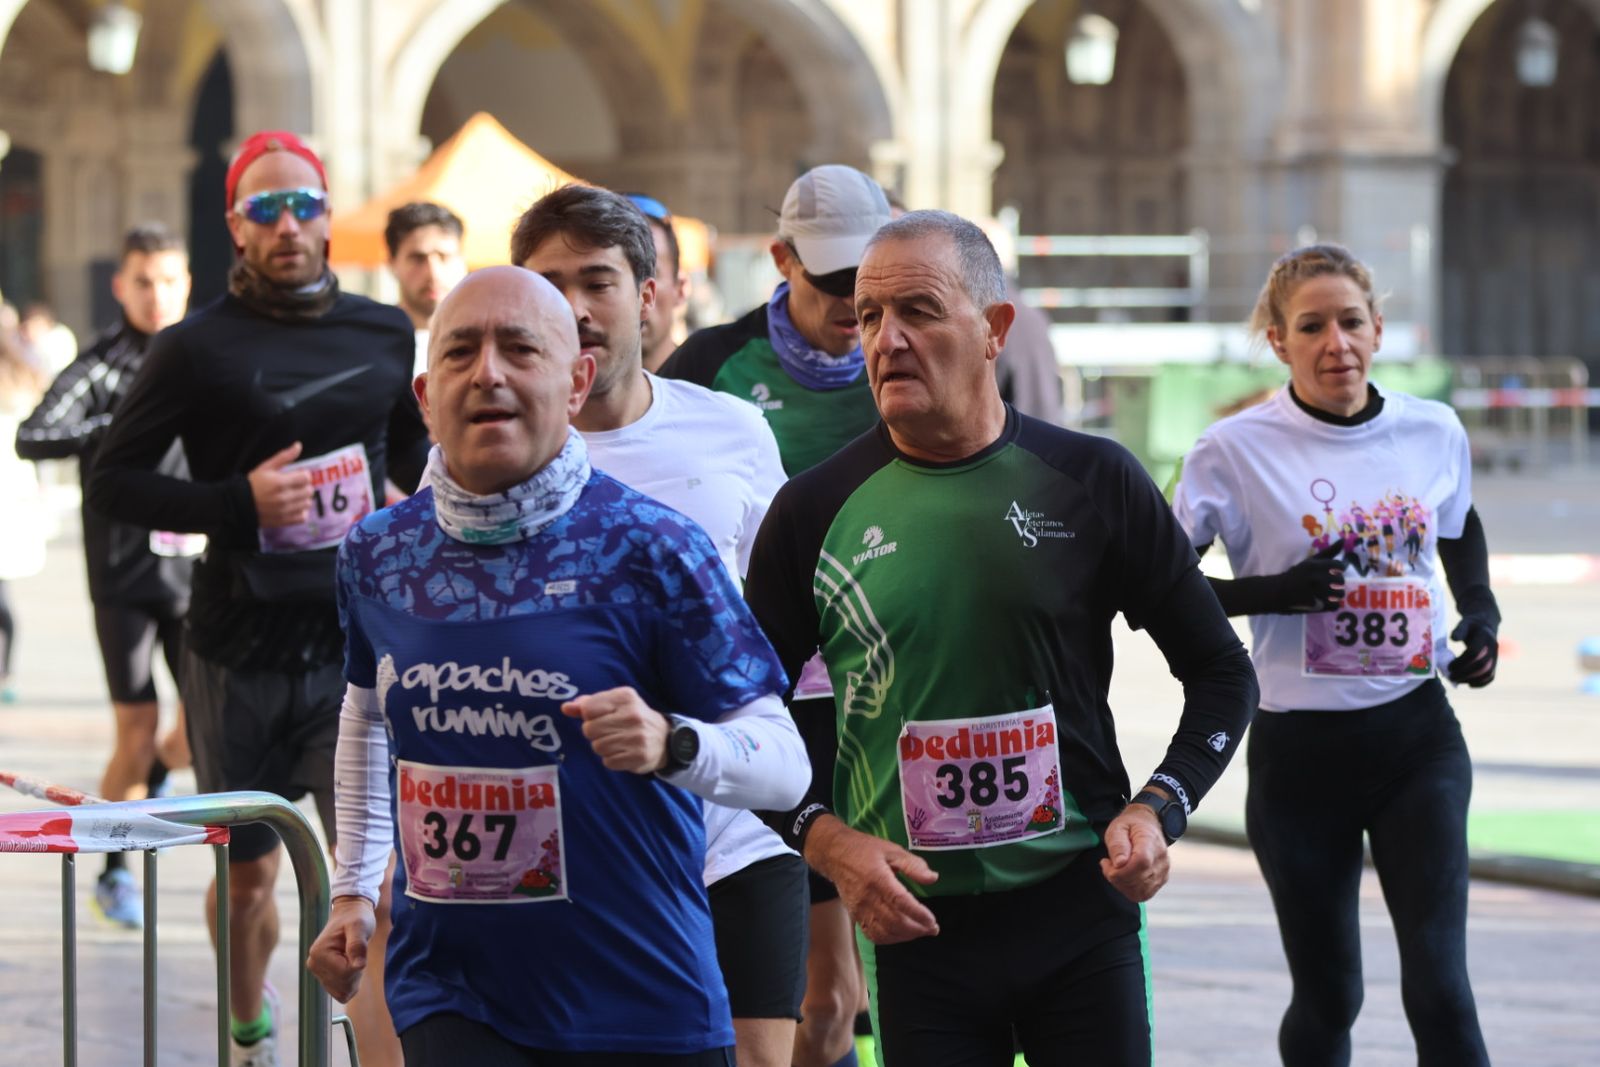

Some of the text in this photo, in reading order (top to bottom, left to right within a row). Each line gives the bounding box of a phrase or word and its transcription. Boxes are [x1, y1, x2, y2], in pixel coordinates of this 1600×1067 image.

[313, 483, 348, 519] 16
[1004, 500, 1045, 521] Atletas
[1010, 517, 1064, 538] Veteranos
[1023, 527, 1076, 548] Salamanca
[852, 541, 897, 566] VIATOR
[1340, 585, 1430, 609] dunia
[1335, 611, 1409, 647] 383
[401, 656, 579, 703] apaches
[411, 703, 562, 752] running
[900, 719, 1055, 761] bedunia
[400, 769, 555, 812] bedunia
[935, 755, 1029, 808] 385
[423, 811, 517, 862] 367
